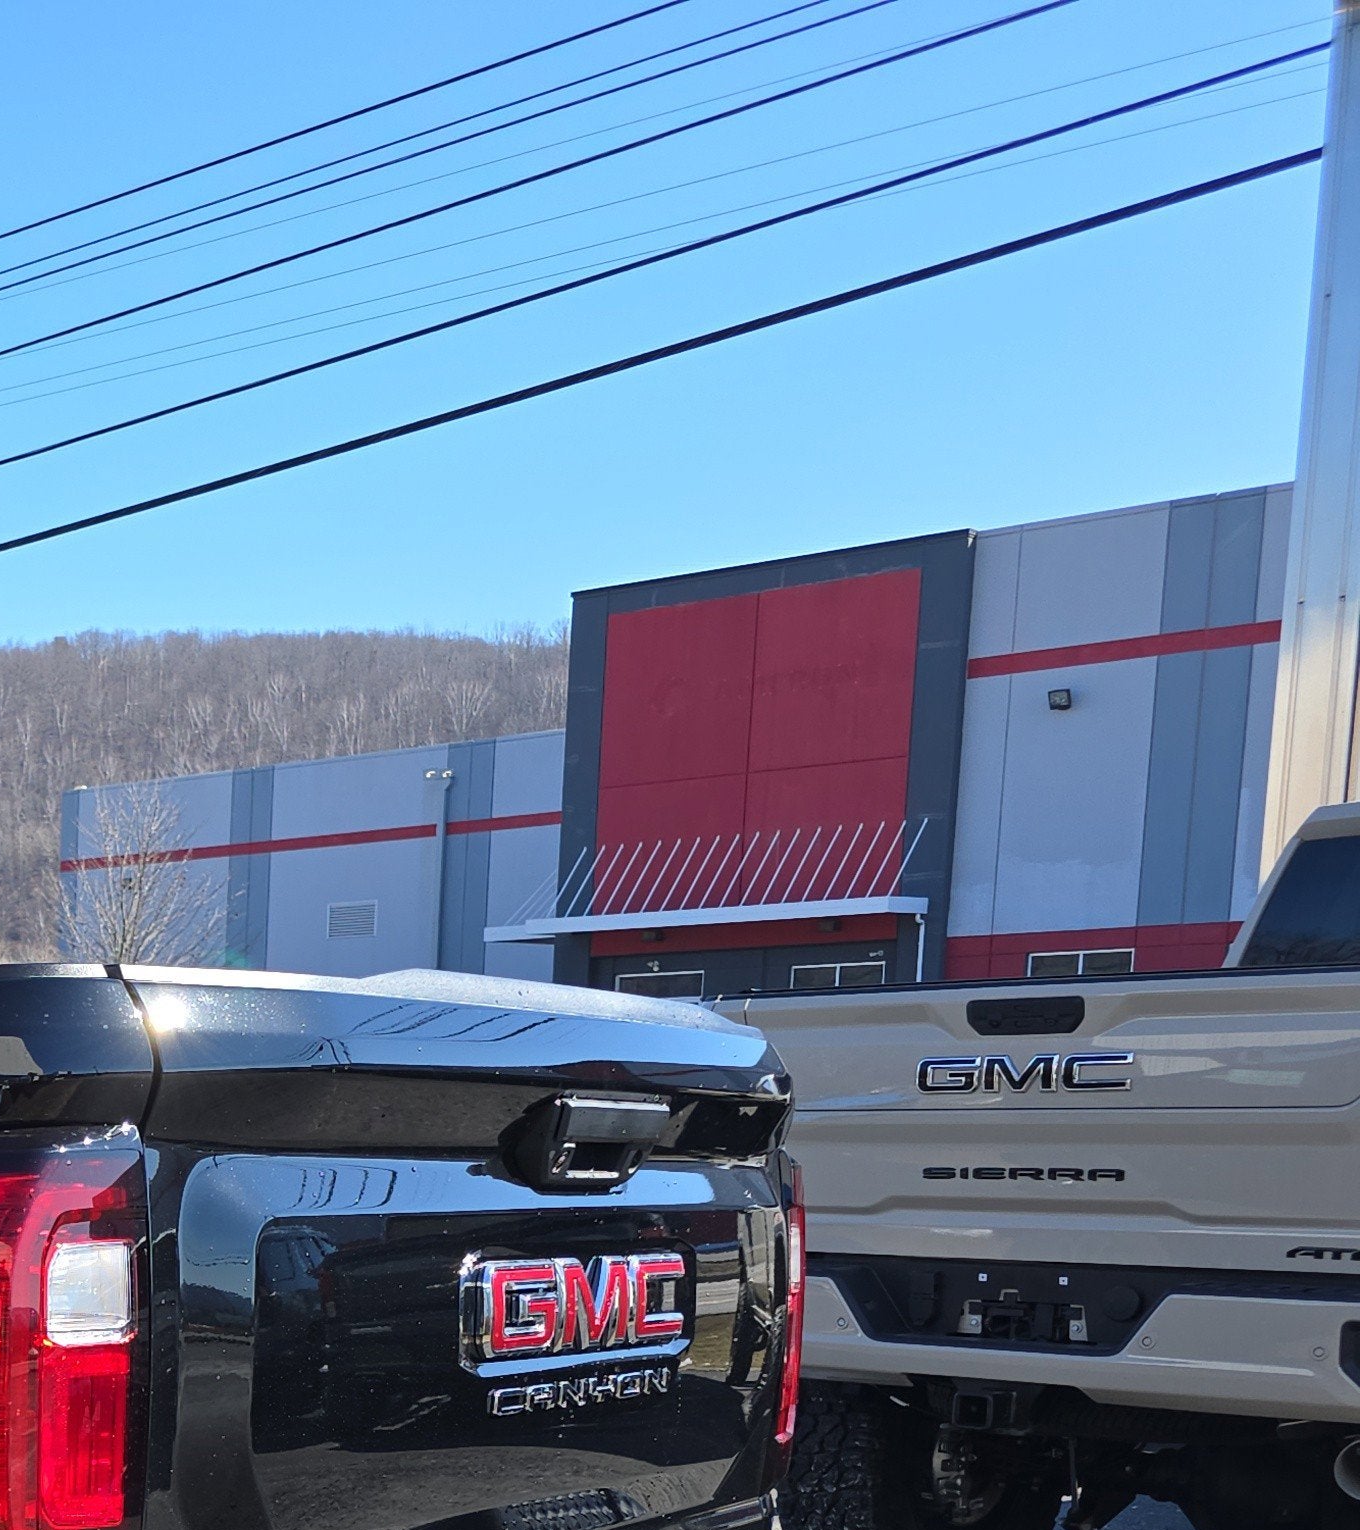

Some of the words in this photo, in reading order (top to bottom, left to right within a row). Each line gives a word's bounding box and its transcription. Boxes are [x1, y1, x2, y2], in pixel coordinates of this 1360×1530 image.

[916, 1052, 1134, 1094] GMC
[922, 1166, 1126, 1182] SIERRA
[483, 1253, 686, 1358] GMC
[487, 1367, 671, 1416] CANYON
